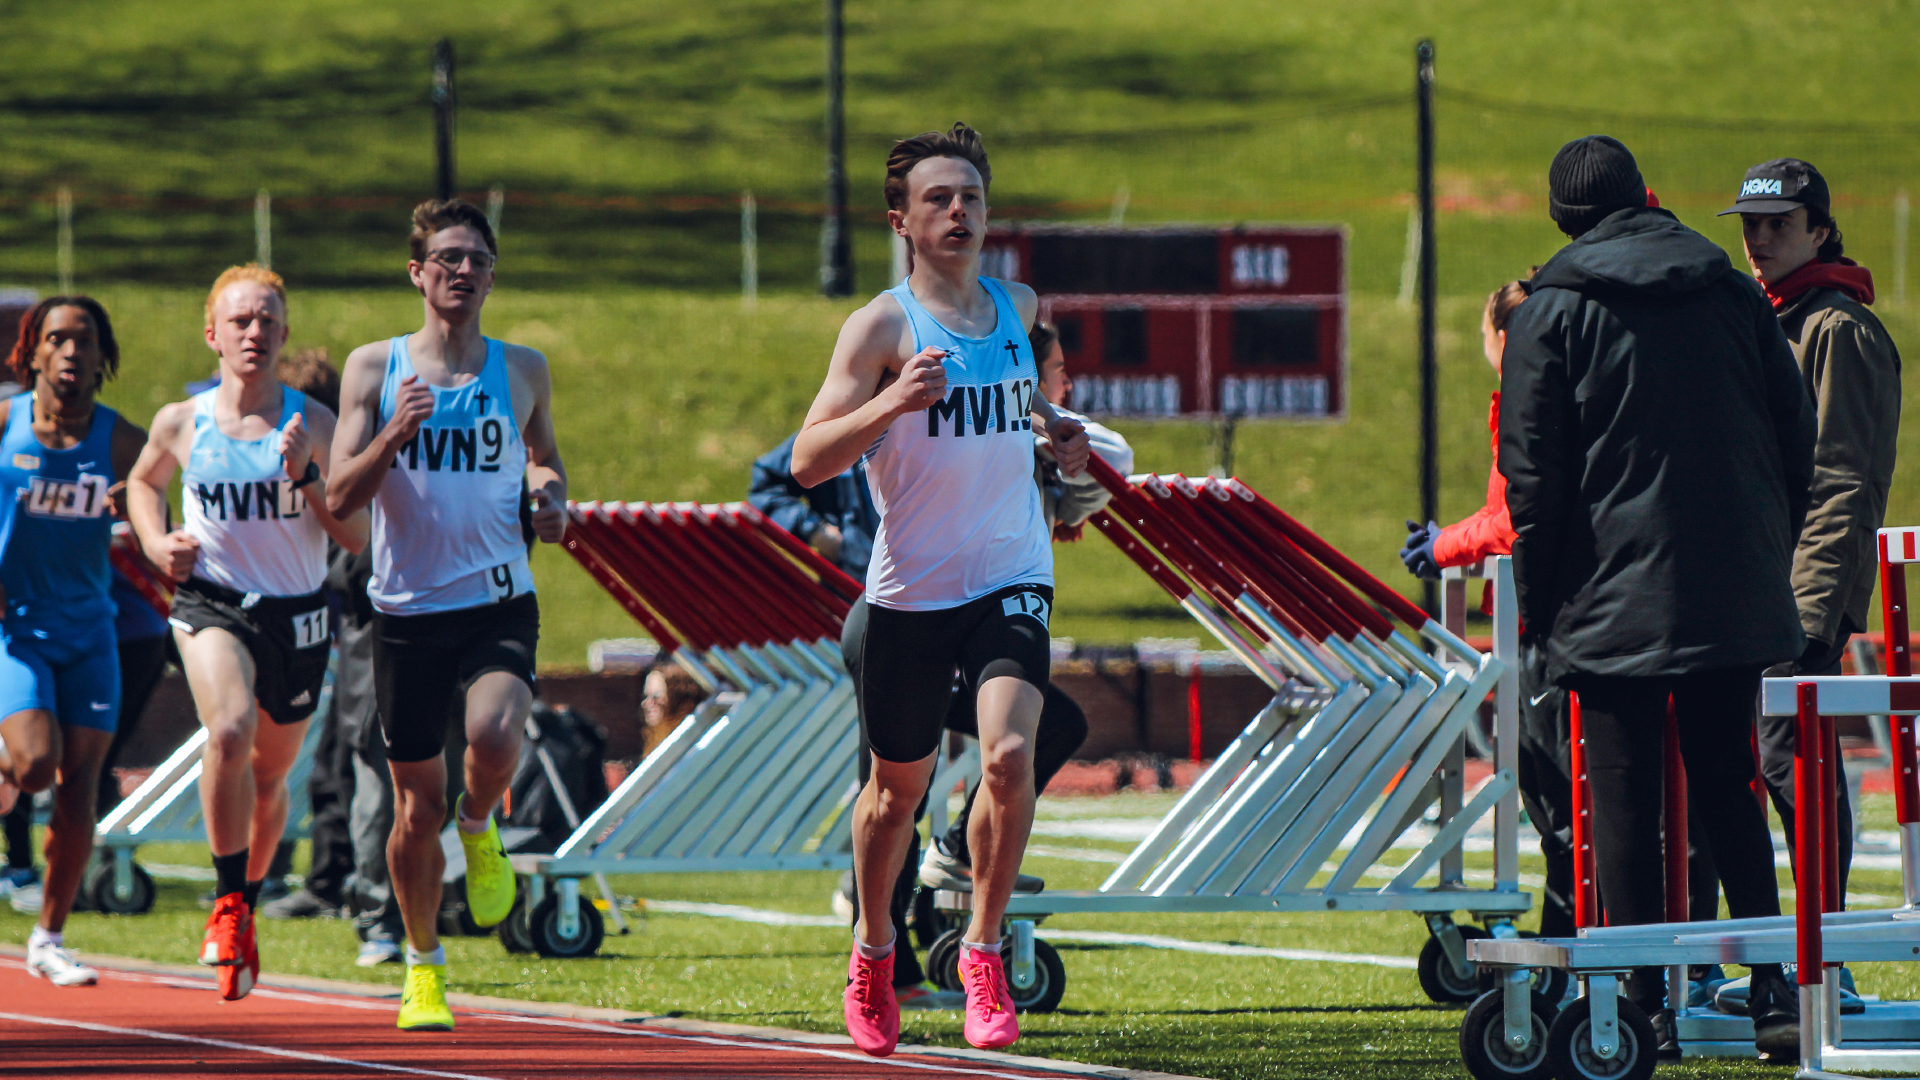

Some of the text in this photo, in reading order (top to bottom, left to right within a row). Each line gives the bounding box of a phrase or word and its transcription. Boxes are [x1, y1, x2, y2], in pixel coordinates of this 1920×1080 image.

[1741, 178, 1782, 197] HOKA
[928, 383, 1031, 437] MV
[1011, 379, 1032, 417] 12
[390, 427, 500, 471] MVN
[482, 419, 503, 462] 9
[83, 482, 97, 513] 1
[198, 479, 301, 521] MVN
[491, 564, 514, 599] 9
[1013, 593, 1045, 623] 12
[303, 611, 324, 644] 11
